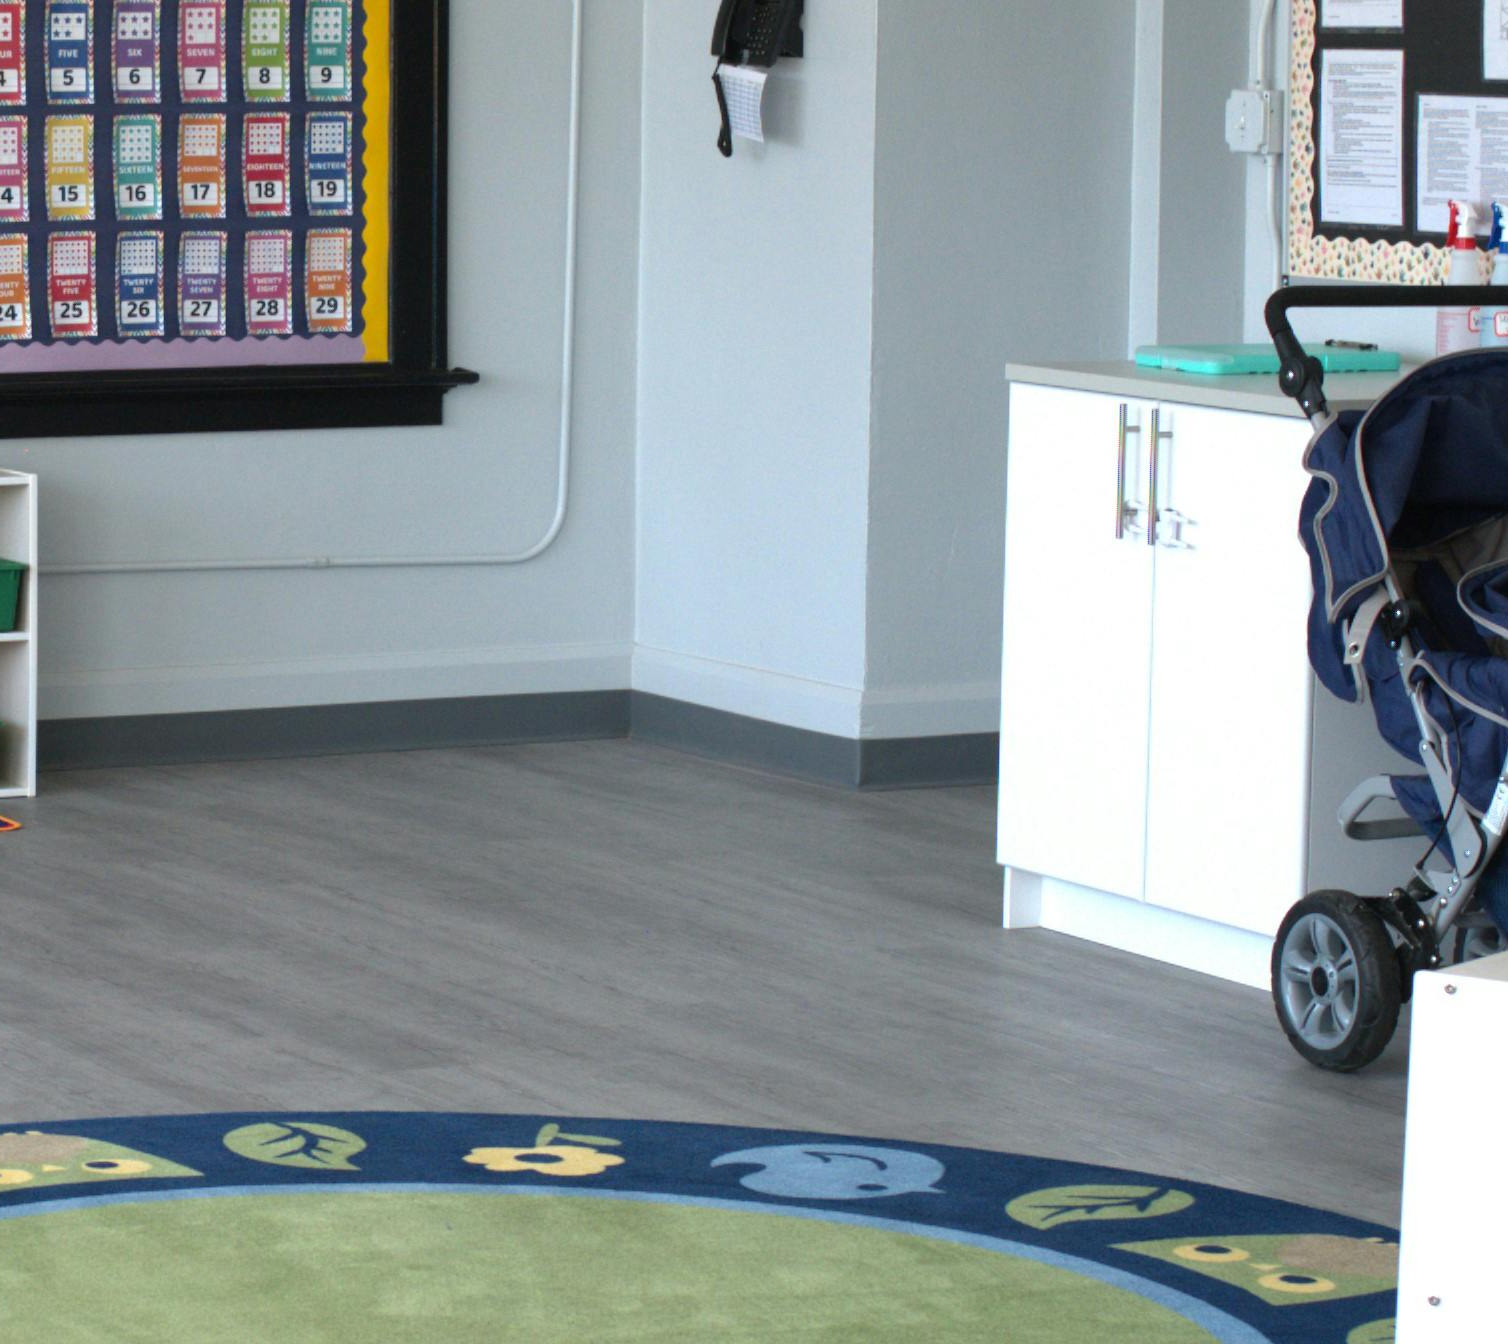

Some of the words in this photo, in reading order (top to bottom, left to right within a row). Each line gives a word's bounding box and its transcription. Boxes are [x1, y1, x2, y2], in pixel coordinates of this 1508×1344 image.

[59, 49, 78, 58] FIVE
[127, 49, 142, 57] SIX
[316, 48, 337, 56] NINE
[63, 70, 74, 85] 5
[129, 69, 140, 84] 6
[196, 69, 206, 84] 7
[259, 68, 270, 83] 8
[321, 67, 332, 83] 9
[118, 166, 153, 174] SIXTEEN
[309, 162, 346, 170] NINETEEN
[59, 186, 78, 201] 15
[126, 186, 146, 201] 16
[191, 185, 210, 199] 17
[255, 182, 275, 198] 18
[317, 181, 337, 196] 19
[56, 279, 87, 287] TWENTY
[187, 278, 217, 286] TWENTY
[253, 277, 283, 285] TWENTY
[63, 287, 79, 295] FIVE
[61, 303, 83, 318] 25
[128, 302, 150, 317] 26
[191, 301, 211, 317] 27
[256, 300, 278, 316] 28
[316, 298, 338, 313] 29
